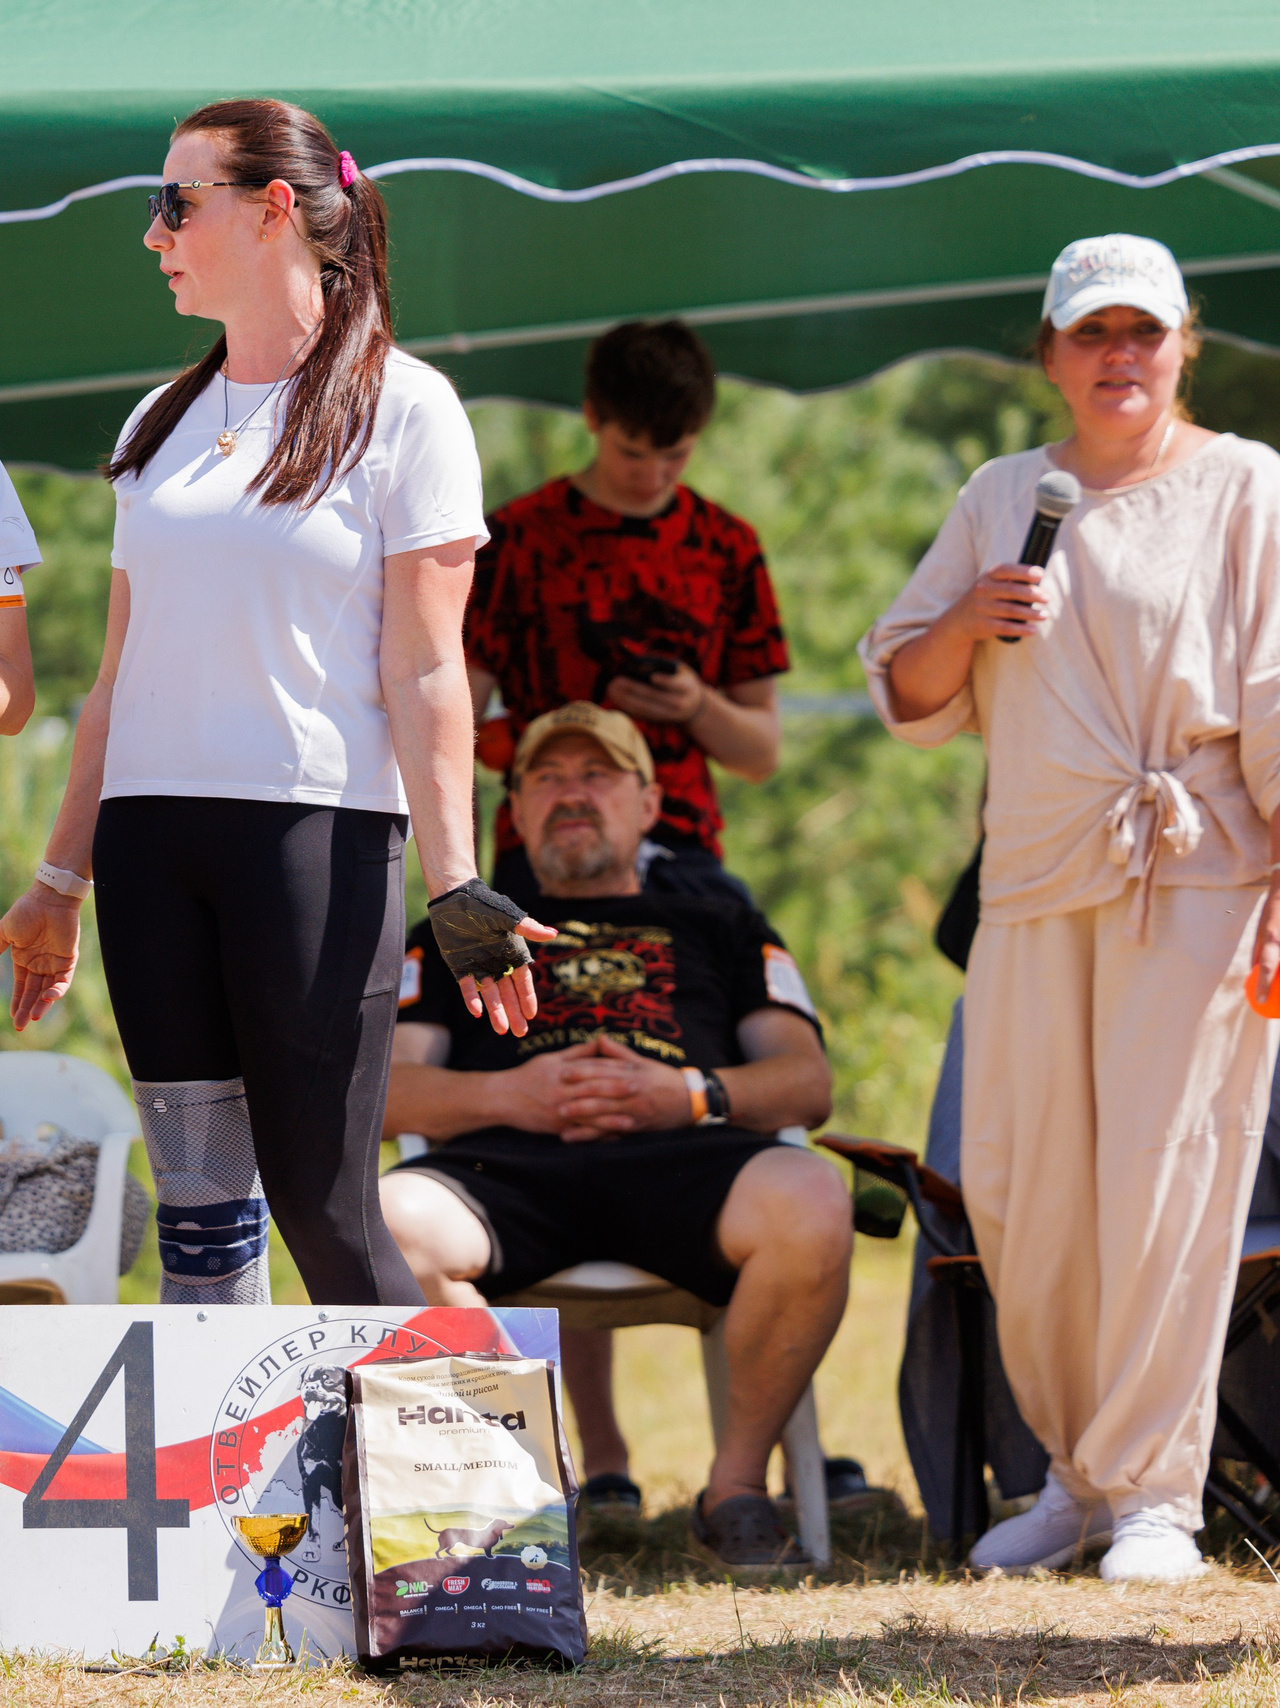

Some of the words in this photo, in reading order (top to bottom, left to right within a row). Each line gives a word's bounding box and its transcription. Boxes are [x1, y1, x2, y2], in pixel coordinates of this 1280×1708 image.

[351, 1325, 448, 1356] КЛУ
[472, 1383, 499, 1397] рисом
[397, 1405, 527, 1431] Hanta
[439, 1427, 490, 1437] premium
[23, 1321, 190, 1601] 4
[414, 1460, 518, 1473] SMALL/MEDIUM
[447, 1579, 466, 1587] FRESH
